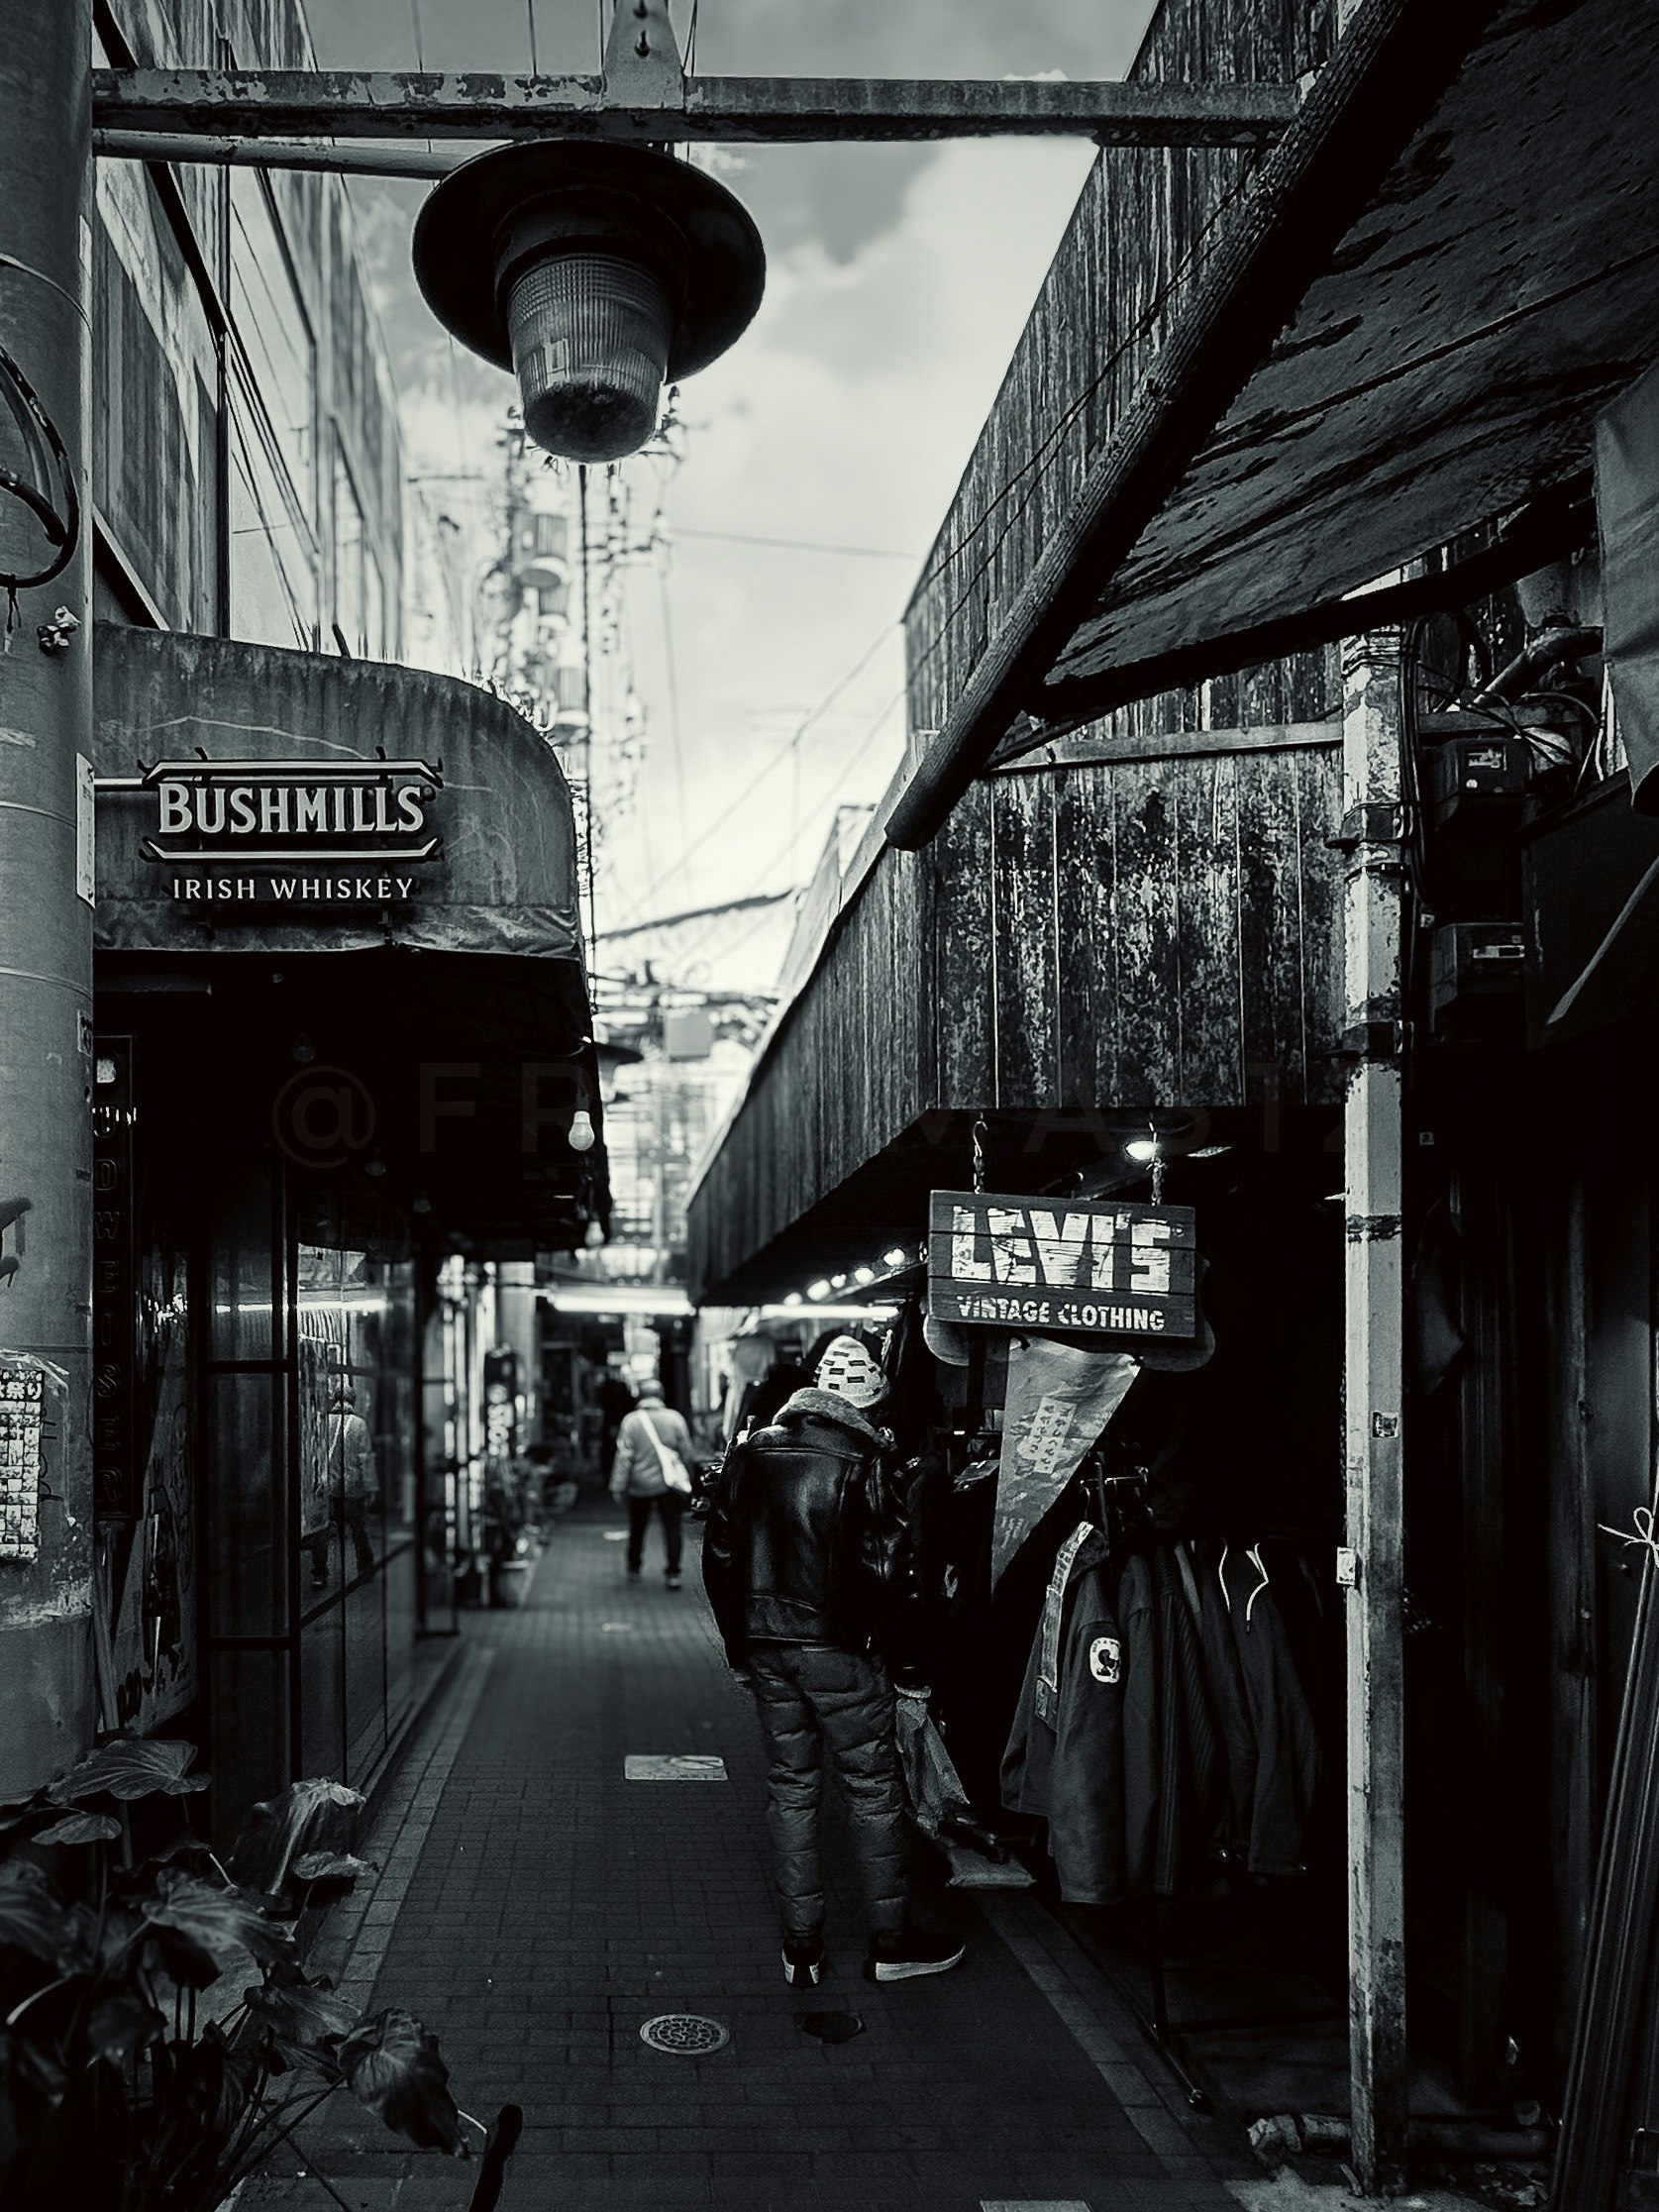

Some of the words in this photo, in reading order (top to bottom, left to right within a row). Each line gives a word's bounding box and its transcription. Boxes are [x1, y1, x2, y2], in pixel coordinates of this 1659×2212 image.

[157, 782, 425, 834] BUSHMILLS
[173, 878, 256, 899] IRISH
[270, 877, 413, 899] WHISKEY
[956, 1295, 1052, 1324] VINTAGE
[1057, 1303, 1166, 1331] CLOTHING
